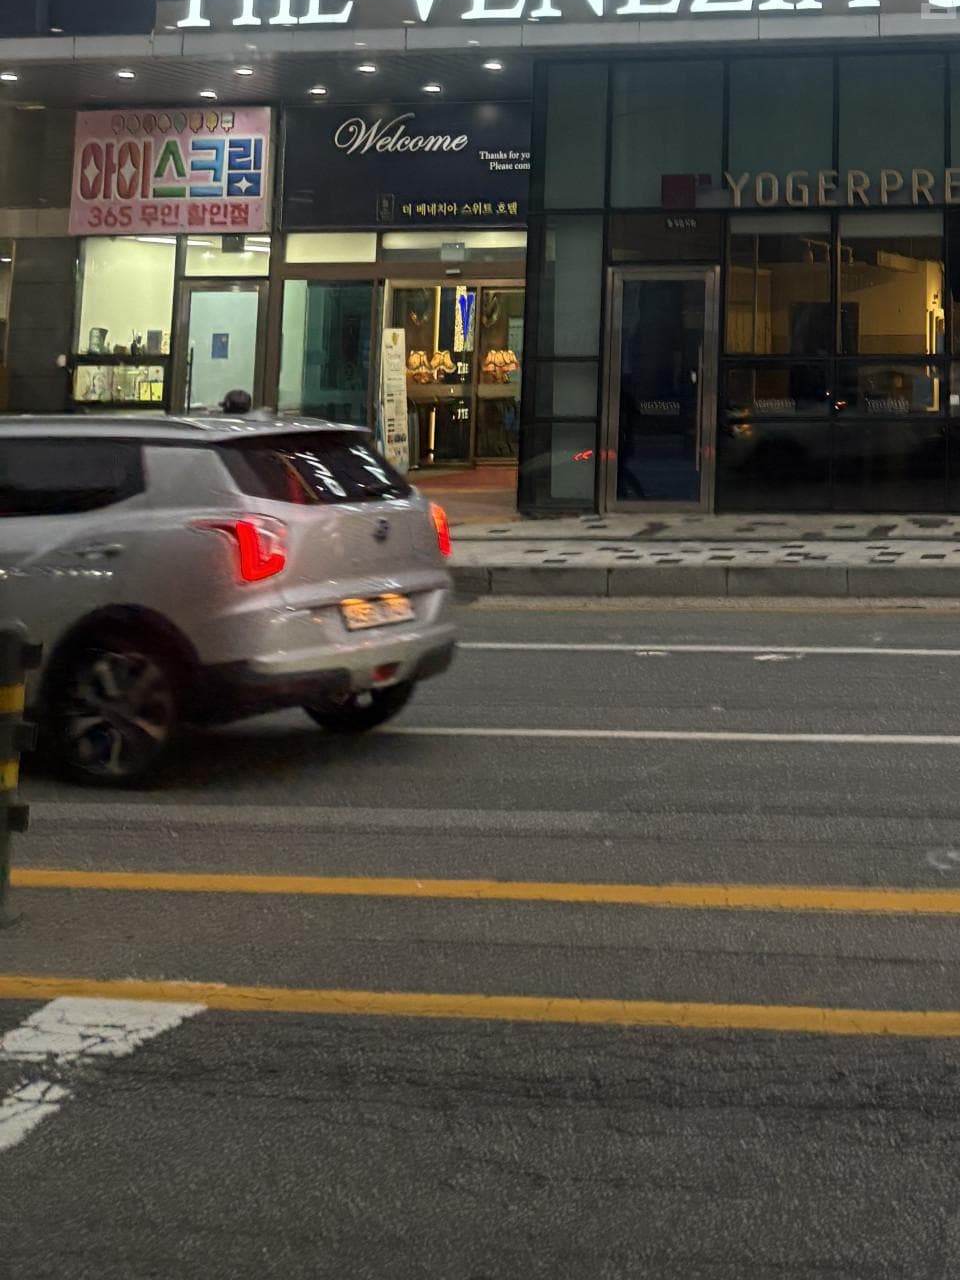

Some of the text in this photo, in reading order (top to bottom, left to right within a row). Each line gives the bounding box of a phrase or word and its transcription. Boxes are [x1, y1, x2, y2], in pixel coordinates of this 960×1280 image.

[334, 112, 469, 156] Welcome
[479, 150, 508, 160] Thanks
[509, 150, 520, 160] for
[489, 161, 514, 170] Please
[80, 137, 263, 200] 아이스크림
[88, 203, 250, 228] 365 무인 할인점
[402, 202, 412, 217] 더
[416, 201, 457, 216] 베네치아
[461, 201, 493, 216] 스위트
[495, 200, 518, 216] 호텔
